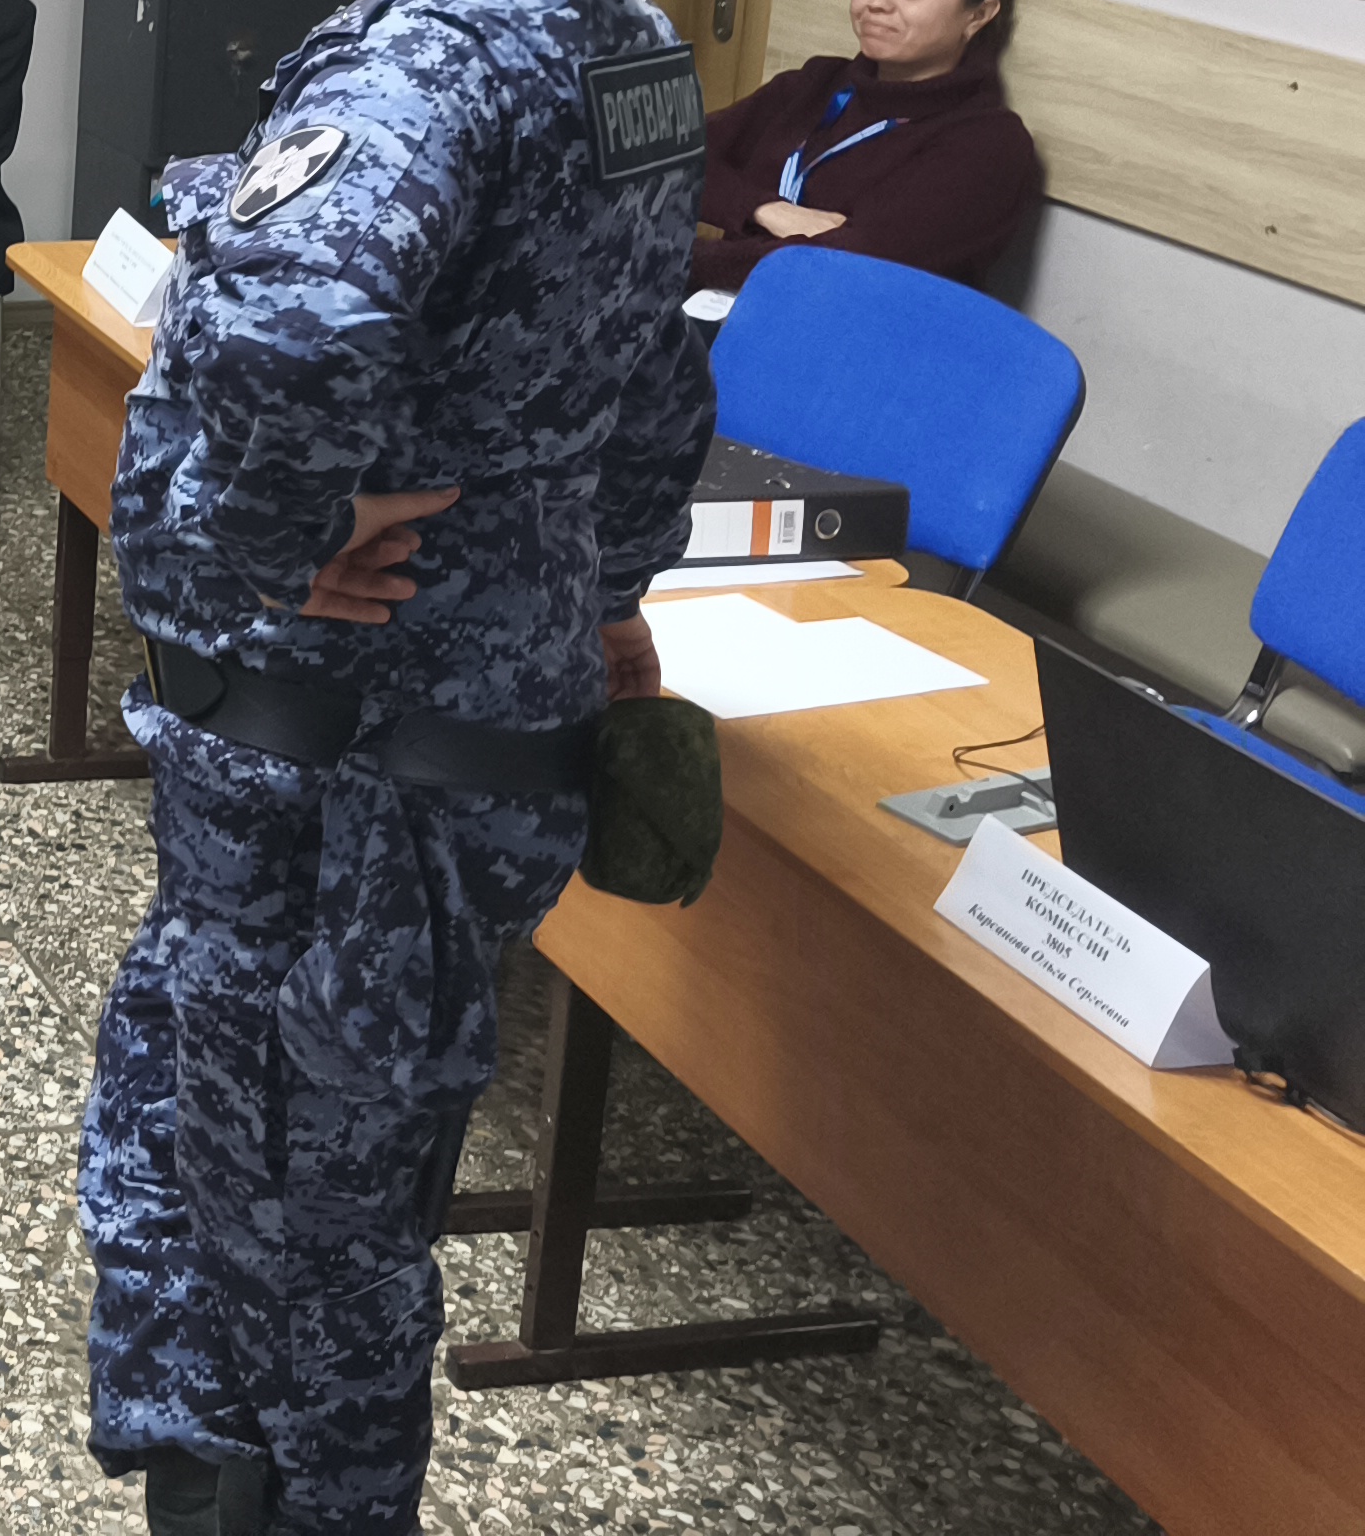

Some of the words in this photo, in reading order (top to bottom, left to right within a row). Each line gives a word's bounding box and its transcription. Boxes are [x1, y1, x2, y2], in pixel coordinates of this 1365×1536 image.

[1021, 868, 1131, 954] ПРЕДСЕДАТЕЛЬ
[1025, 895, 1109, 962] КОМИССИИ
[1042, 932, 1073, 959] 3805
[968, 903, 1031, 955] Кирсанова
[1031, 950, 1067, 982] Ольга
[1068, 976, 1130, 1028] Сергеевна
